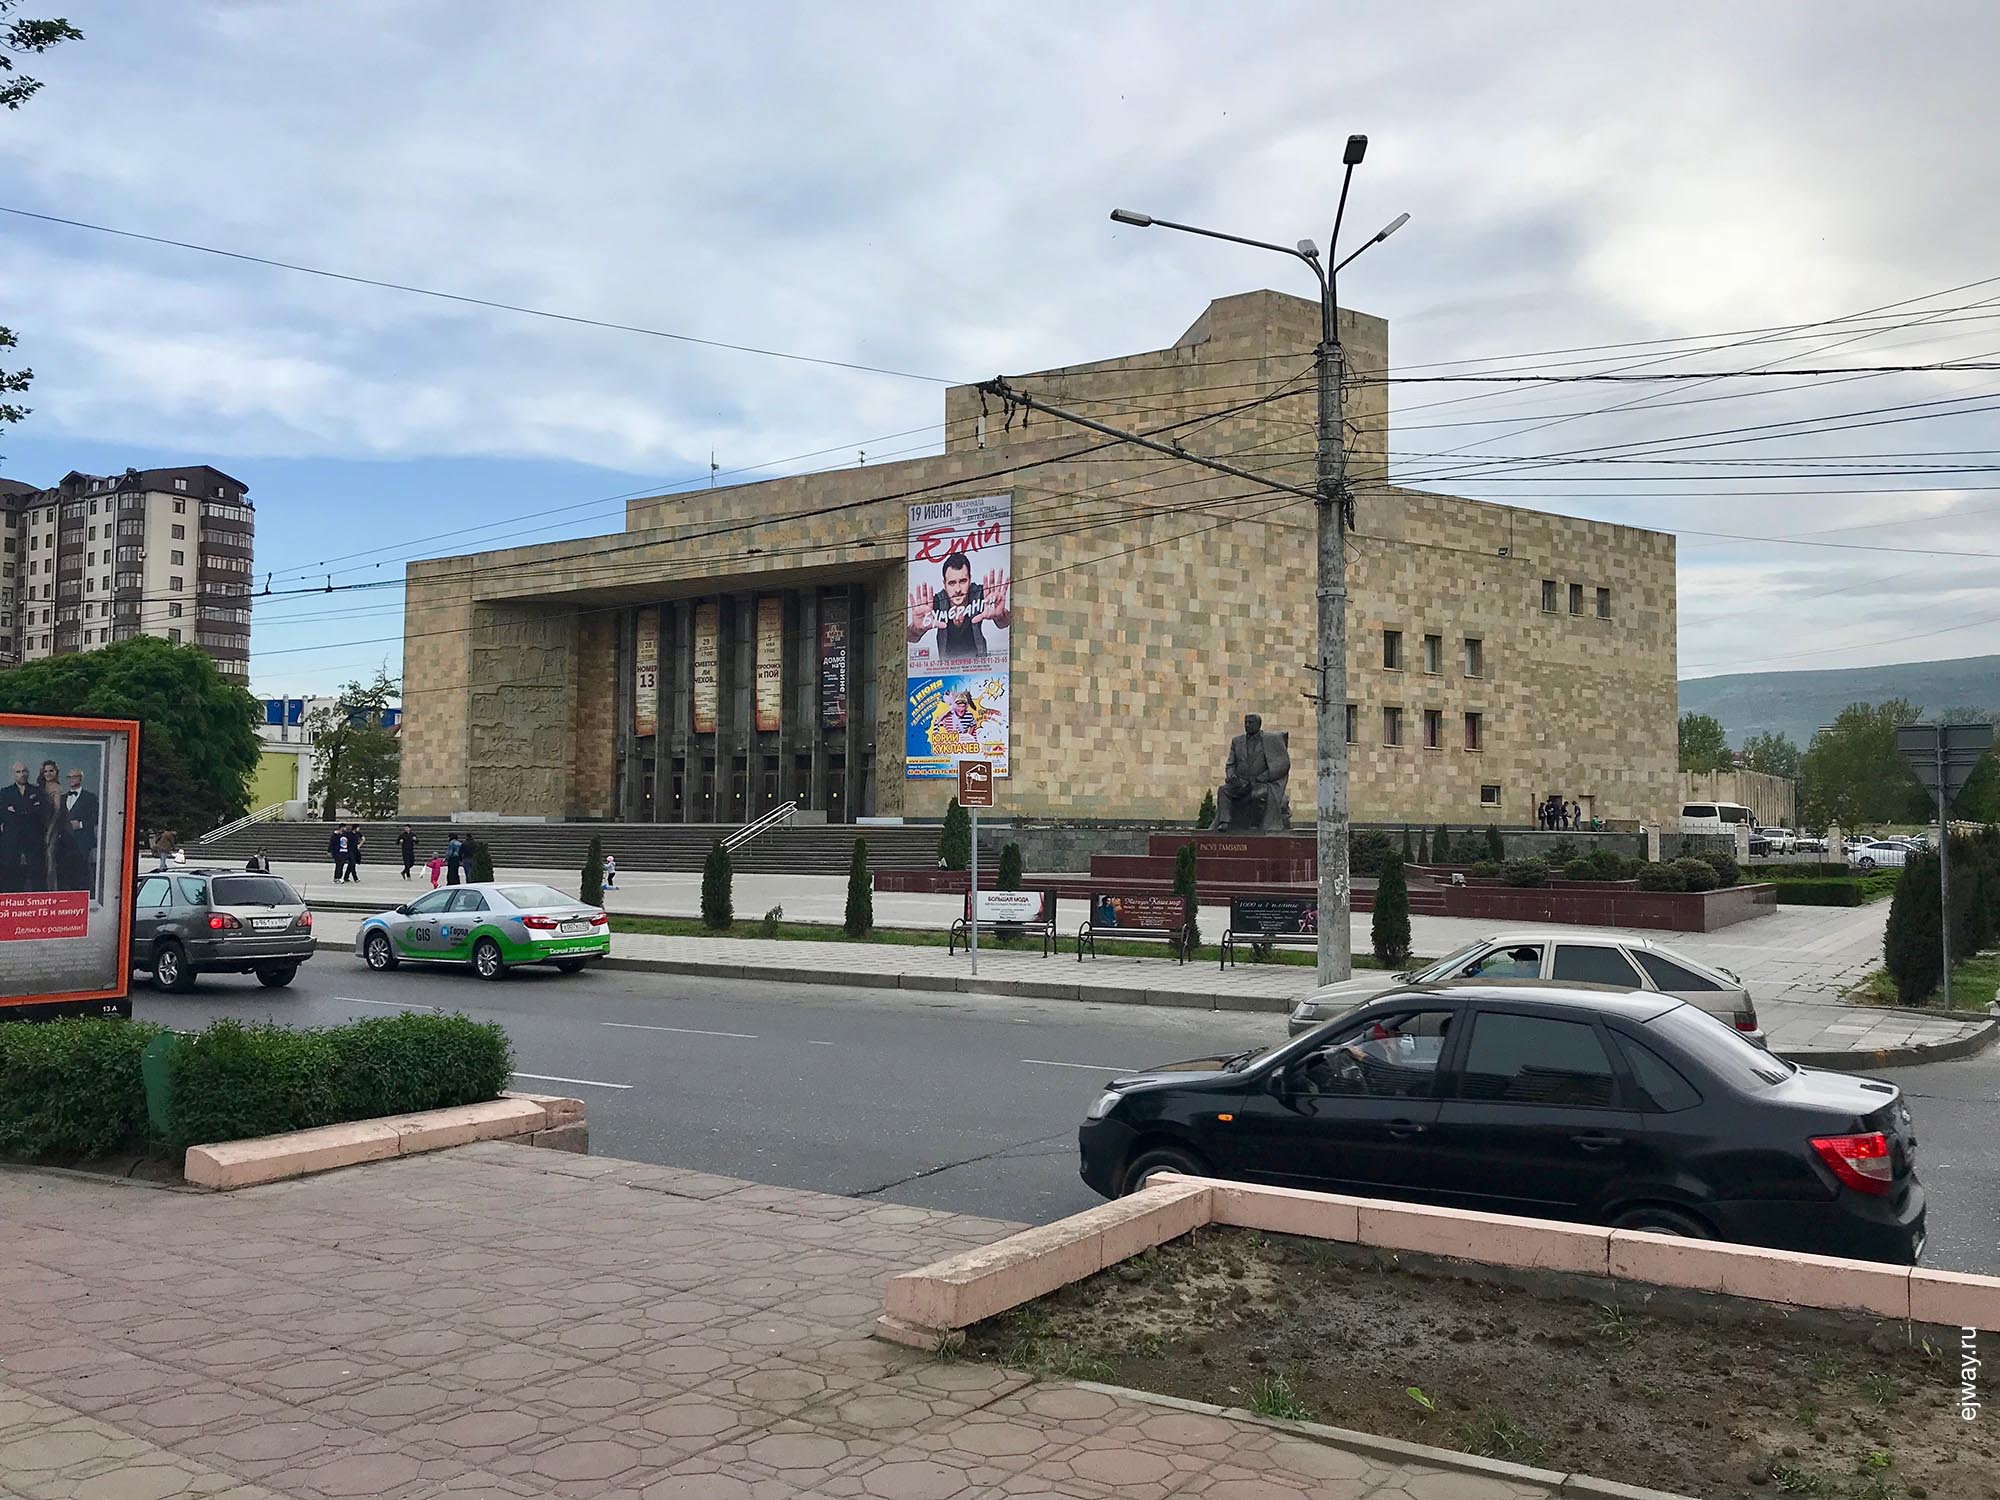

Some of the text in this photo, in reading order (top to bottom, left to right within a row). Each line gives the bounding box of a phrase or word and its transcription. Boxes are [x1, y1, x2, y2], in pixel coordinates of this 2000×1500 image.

[911, 503, 953, 521] 19 ИЮНЯ
[764, 669, 779, 679] ПОЙ
[640, 673, 655, 688] 13
[932, 732, 960, 742] ЮРИЙ
[932, 742, 980, 755] КУКЛАЧЕВ
[27, 897, 57, 906] Smart»
[11, 908, 36, 917] пакет
[38, 907, 48, 917] ГБ
[58, 908, 85, 918] минут
[15, 926, 40, 935] Делись
[48, 924, 84, 934] родными!
